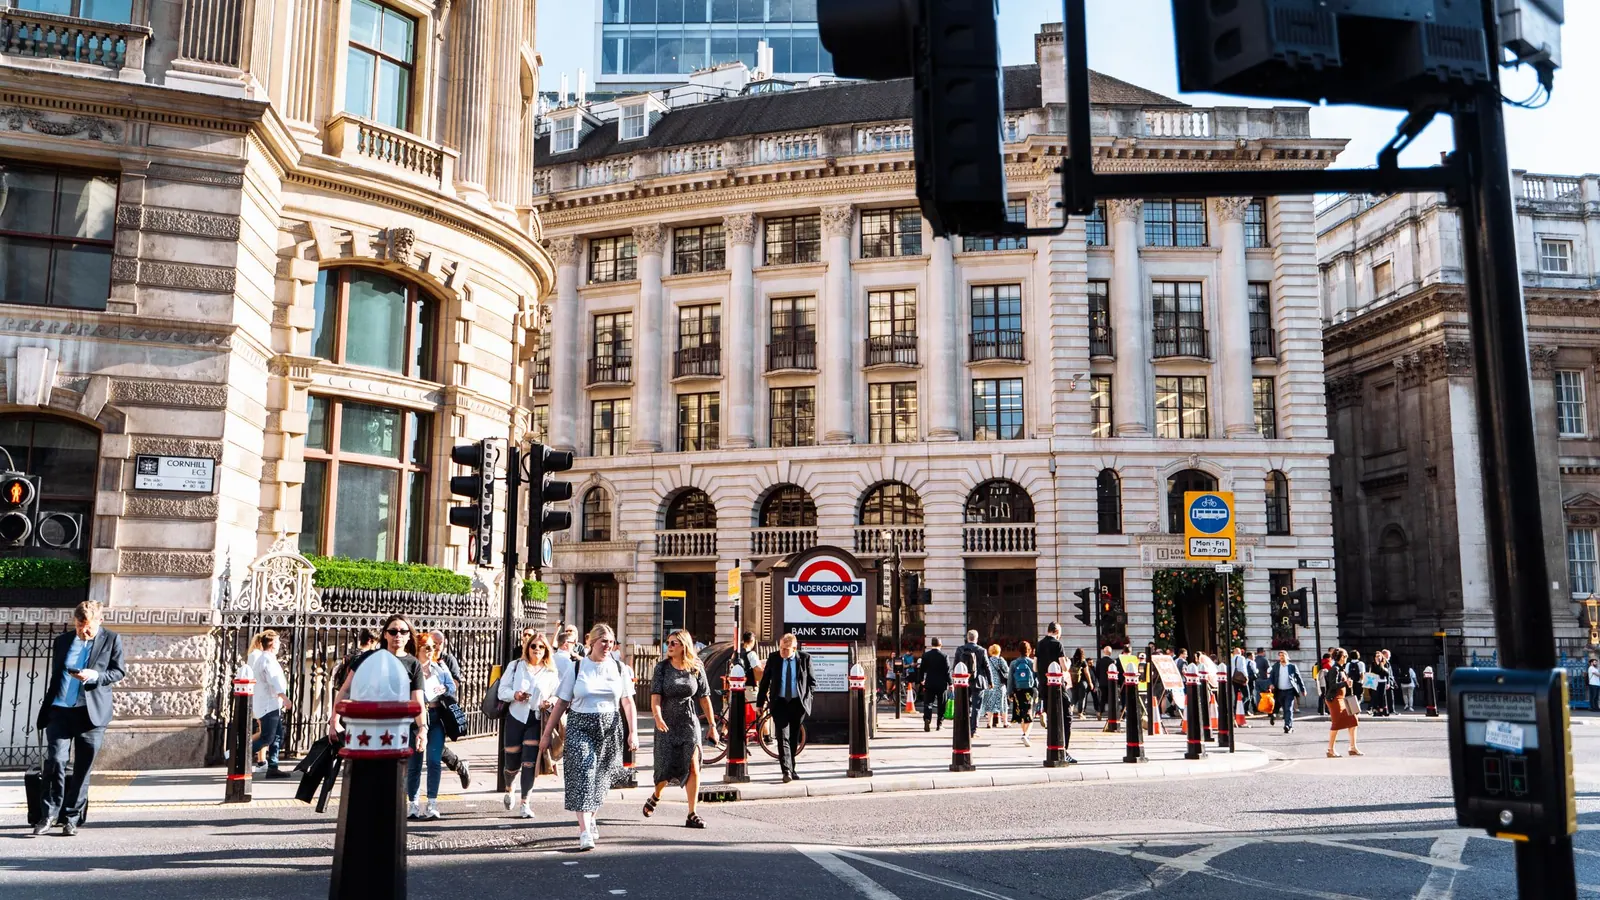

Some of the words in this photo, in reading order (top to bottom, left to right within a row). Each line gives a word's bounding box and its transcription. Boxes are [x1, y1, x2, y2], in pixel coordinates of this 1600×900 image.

[166, 459, 207, 469] CORNHILL
[791, 627, 817, 636] BANK
[820, 627, 859, 636] STATION
[1467, 694, 1533, 704] PEDESTRIANS
